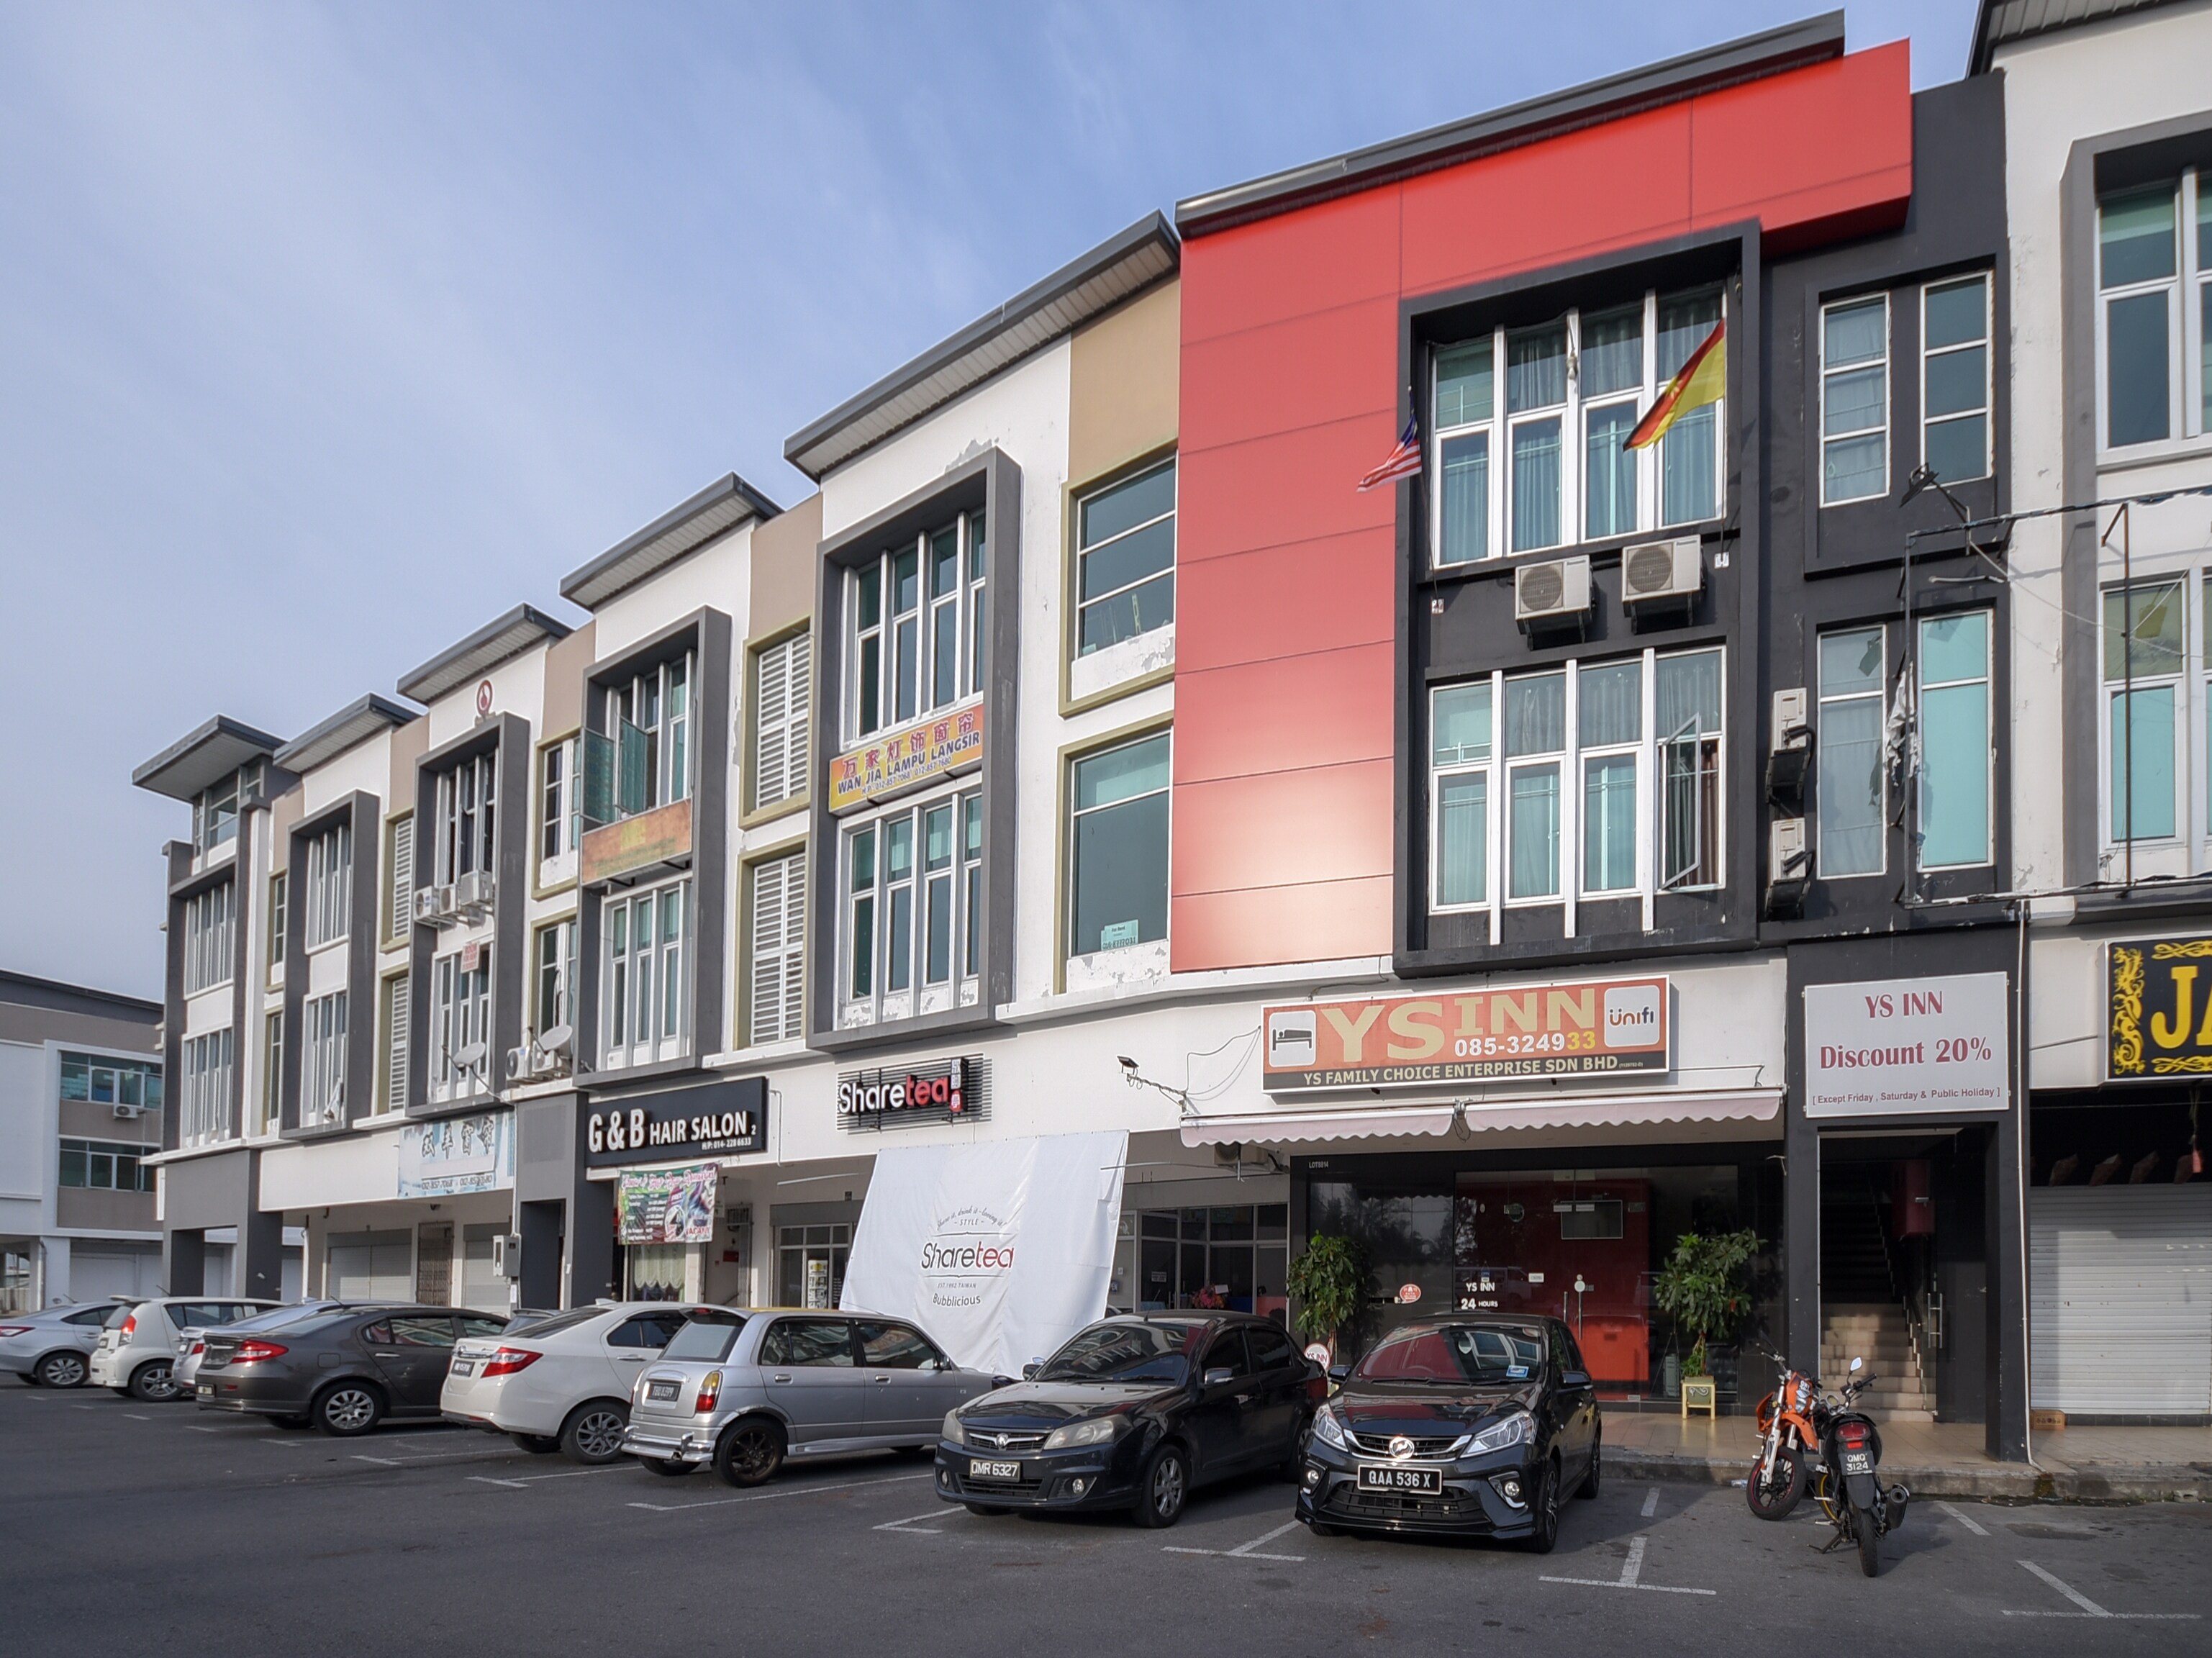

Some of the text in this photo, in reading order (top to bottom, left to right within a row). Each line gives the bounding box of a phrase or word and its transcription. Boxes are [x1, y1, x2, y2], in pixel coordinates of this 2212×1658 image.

[838, 732, 980, 794] WAN JIA LAMPU LANGSIR
[1865, 991, 1942, 1018] YS INN
[1320, 988, 1595, 1063] YS INN
[1454, 1030, 1596, 1057] 085-324933
[1821, 1036, 1992, 1069] Discount 20%
[1304, 1073, 1321, 1085] YS
[1326, 1069, 1379, 1084] FAMILY
[1383, 1066, 1440, 1081] CHOICE
[1445, 1060, 1541, 1078] ENTERPRISE
[1551, 1059, 1577, 1073] SDN
[1584, 1055, 1618, 1070] BHD
[839, 1074, 948, 1113] Sharetea
[1818, 1095, 1845, 1104] Except
[1848, 1093, 1873, 1102] Friday
[1881, 1091, 1918, 1101] Saturday
[1921, 1090, 1926, 1099] &
[1931, 1089, 1959, 1098] Public
[1962, 1087, 1994, 1097] Holiday
[589, 1108, 756, 1152] G & B HAIR SALON 2
[922, 1241, 1014, 1269] Sharetea
[933, 1292, 981, 1307] Bubblicious
[1466, 1283, 1495, 1292] YS INN
[1461, 1298, 1476, 1310] 24
[1316, 1352, 1328, 1362] INN
[992, 1463, 1017, 1477] 6327
[1369, 1470, 1431, 1487] QAA 536 X
[1846, 1462, 1869, 1471] 3124
